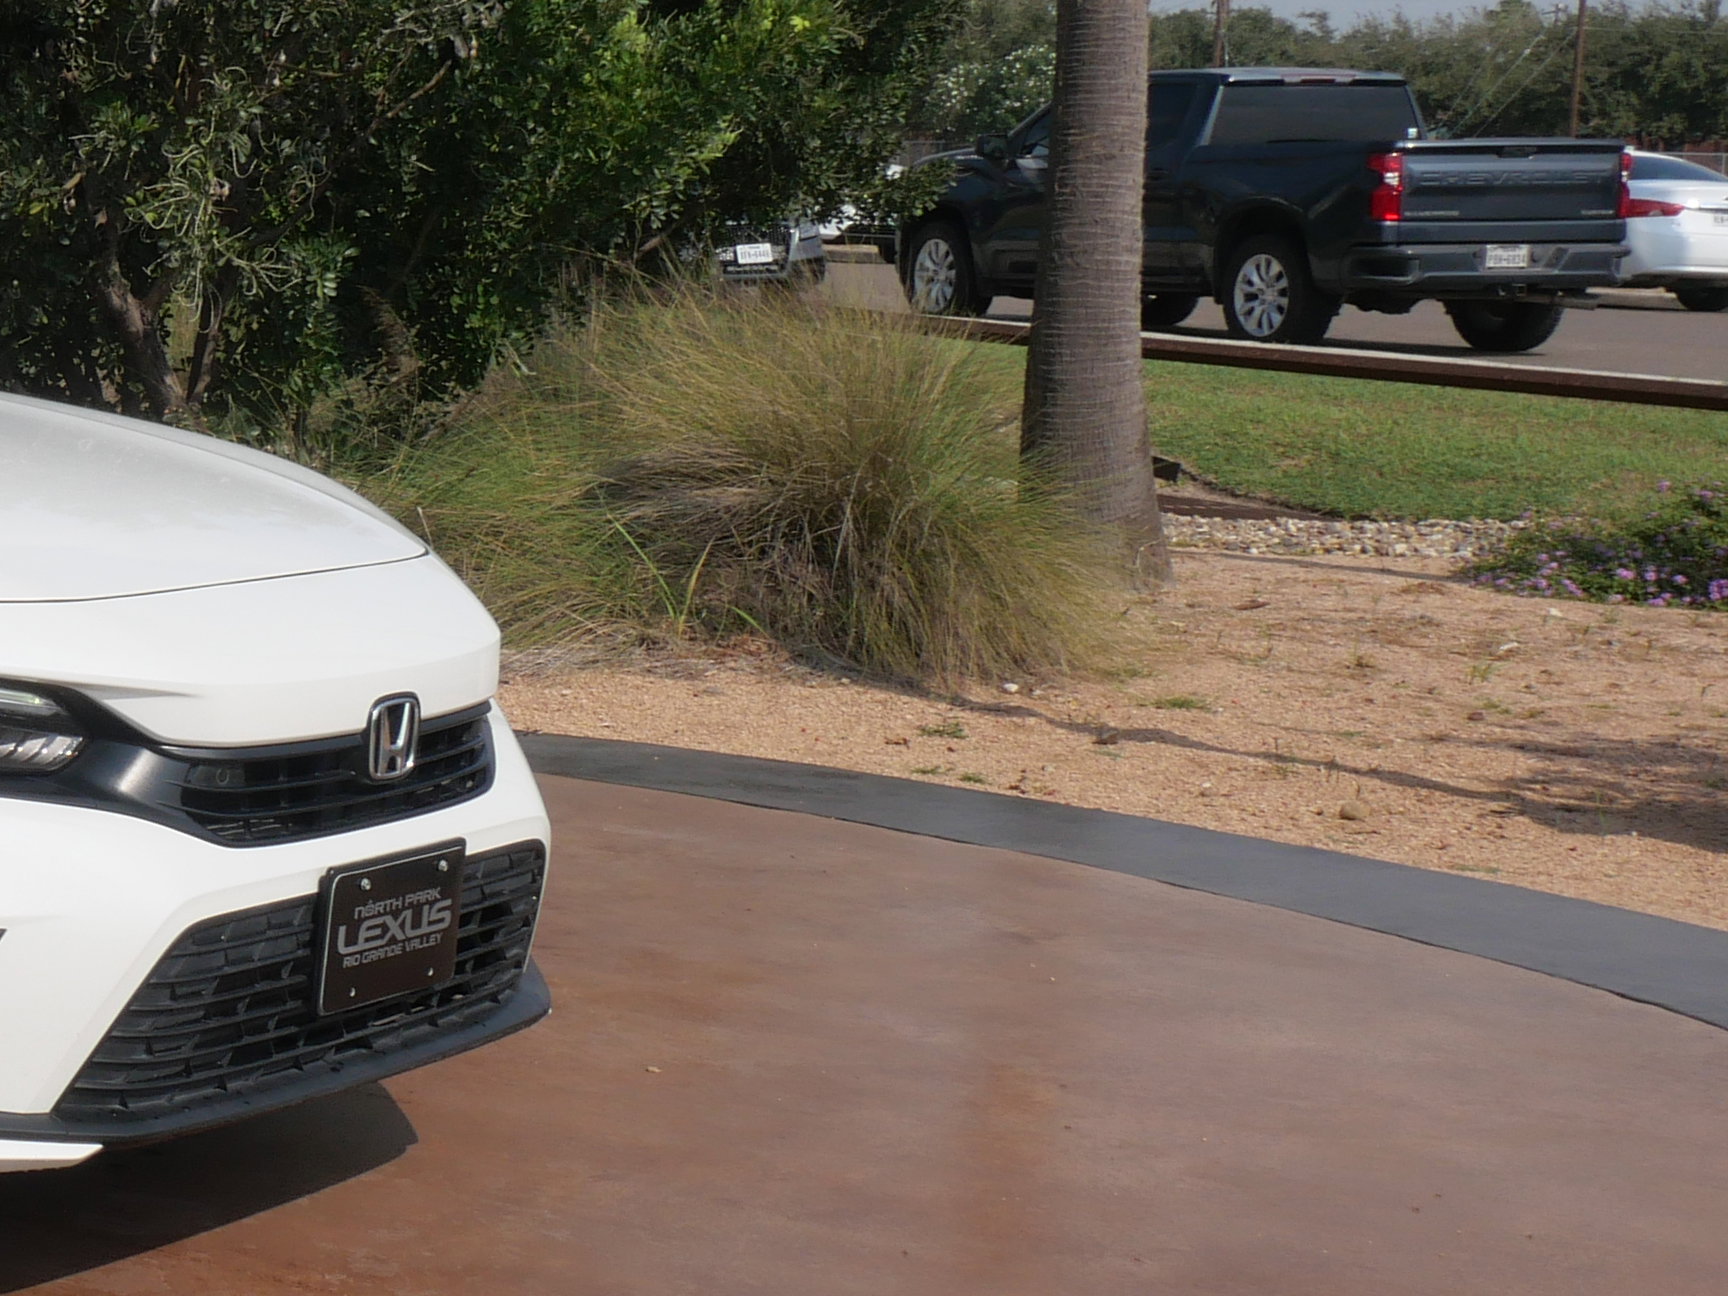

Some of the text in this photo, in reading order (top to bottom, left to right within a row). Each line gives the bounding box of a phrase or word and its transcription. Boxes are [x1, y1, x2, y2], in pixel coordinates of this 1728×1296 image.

[1419, 170, 1609, 185] CHEVROLET
[354, 887, 442, 920] NORTH PARK
[337, 898, 453, 956] LEXUS
[343, 932, 444, 969] RIO GRANDE VALLEY
